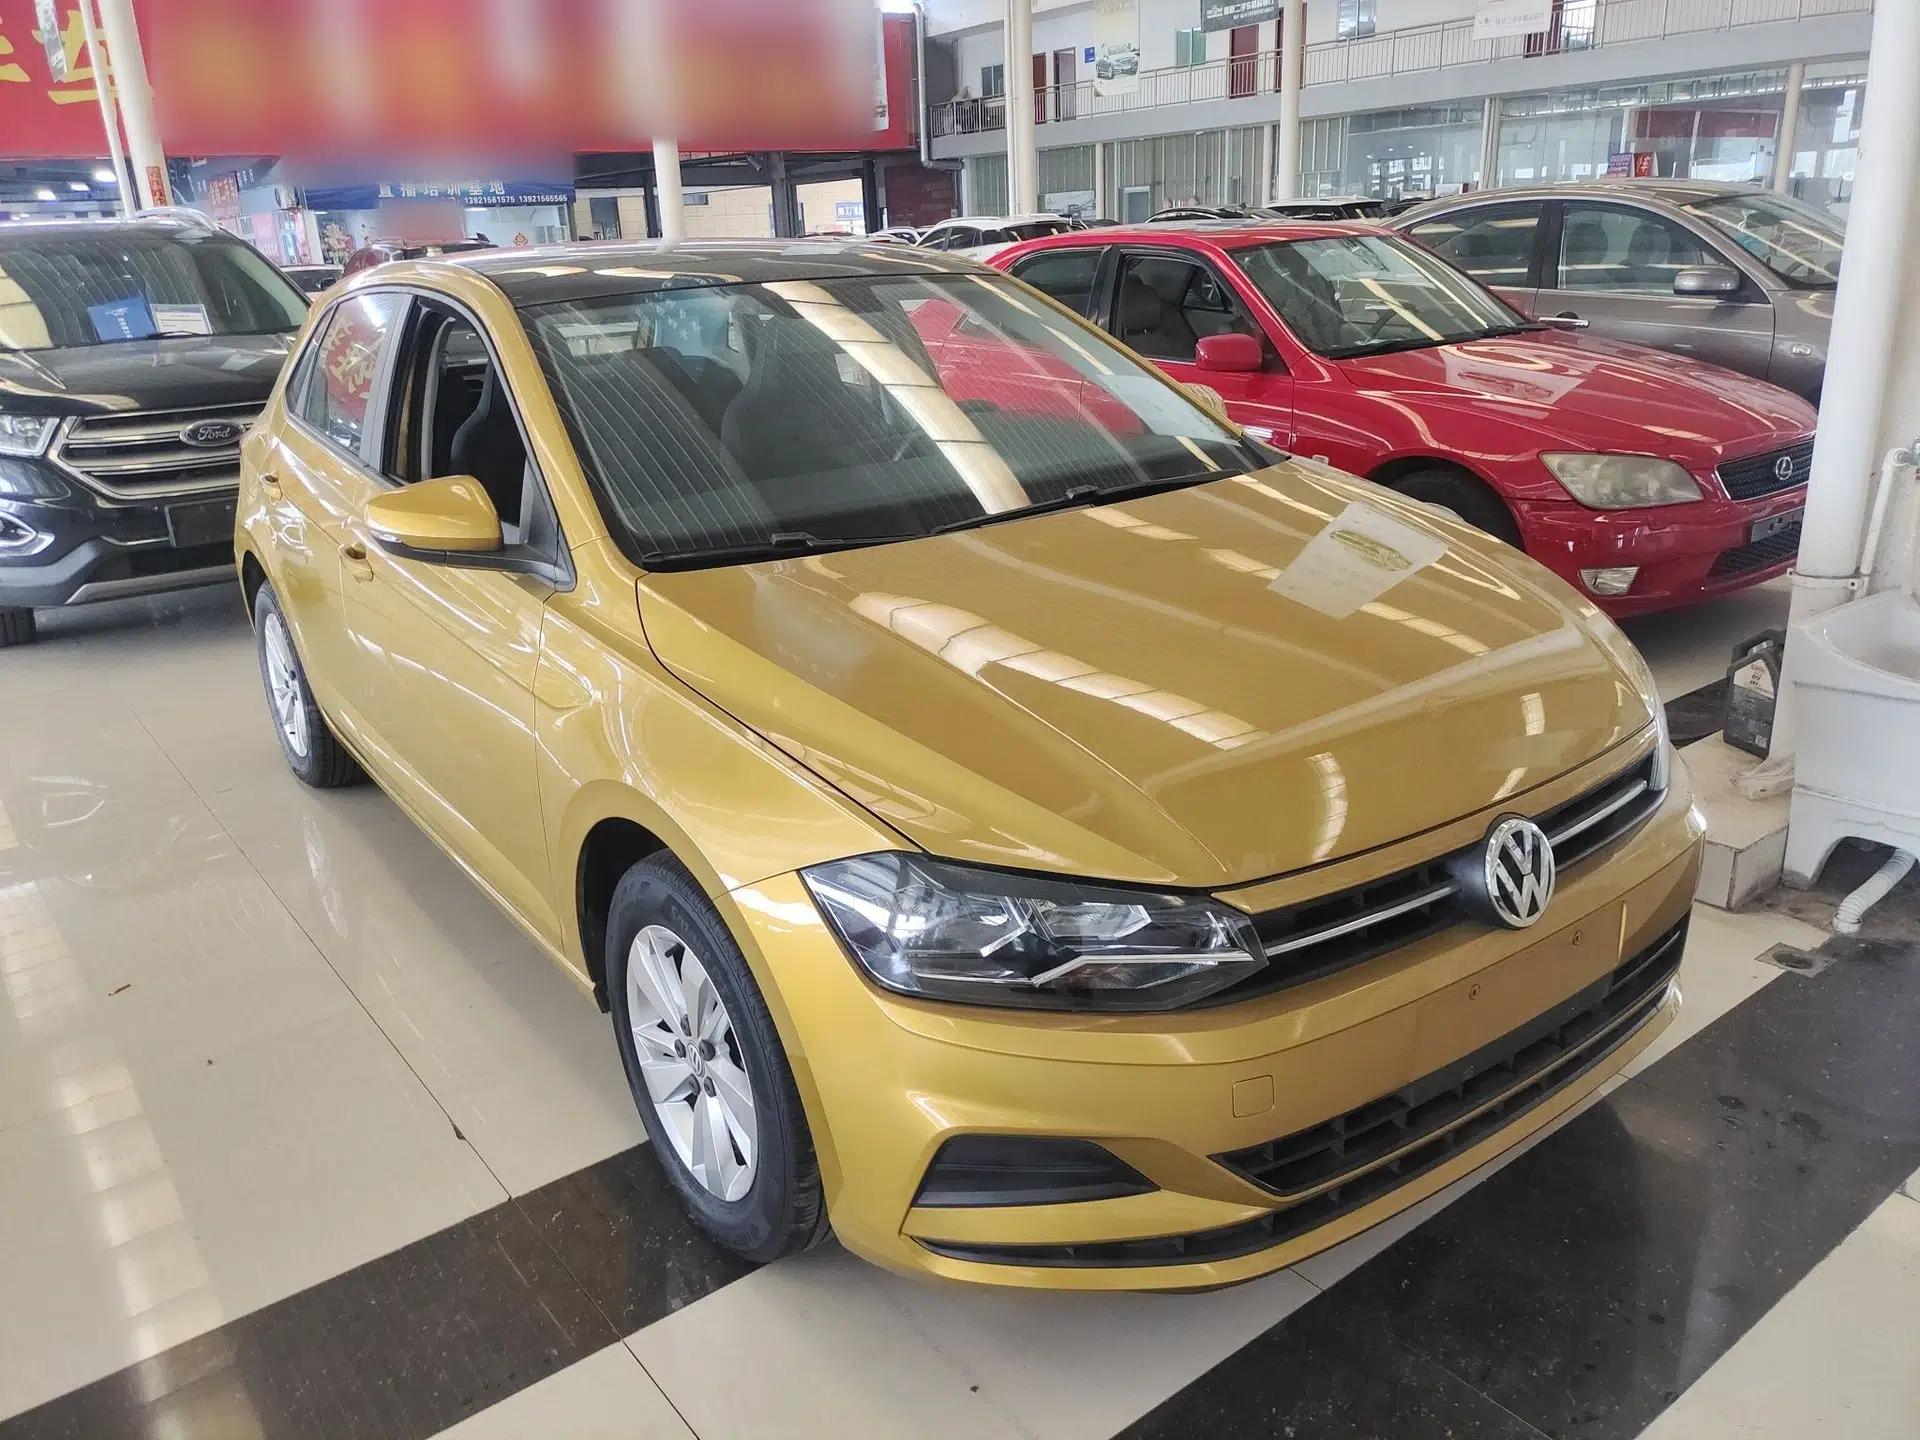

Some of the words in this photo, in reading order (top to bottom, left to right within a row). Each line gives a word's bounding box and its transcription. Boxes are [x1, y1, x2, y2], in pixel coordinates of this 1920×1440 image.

[378, 180, 505, 198] 直播培训基地
[198, 425, 230, 441] Ford
